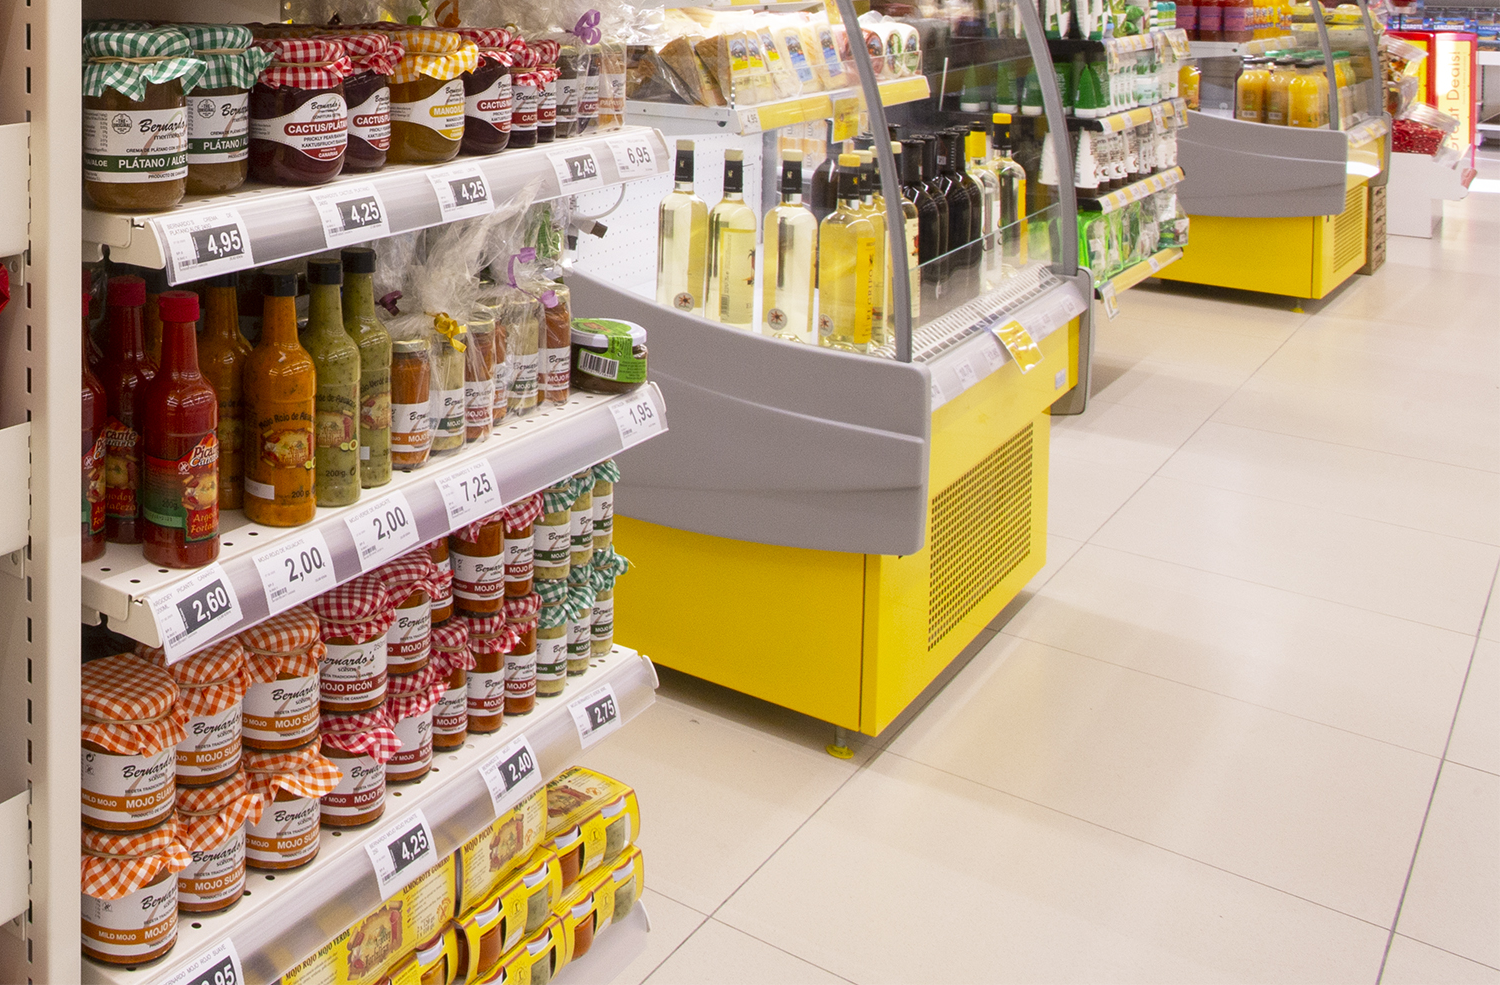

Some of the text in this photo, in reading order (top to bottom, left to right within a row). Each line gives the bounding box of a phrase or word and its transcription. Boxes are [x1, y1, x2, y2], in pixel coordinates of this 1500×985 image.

[203, 139, 239, 150] PLÁTANO
[119, 155, 186, 169] PLÁTANO ALOE
[275, 413, 290, 424] Rojo
[286, 538, 305, 552] AGUACATE
[176, 580, 194, 593] PICANTE
[197, 568, 215, 582] CANARIO
[320, 680, 373, 692] MOJO PICÓN
[275, 716, 300, 729] MOJO
[196, 751, 223, 763] MOJO
[97, 799, 117, 807] MOJO
[126, 796, 155, 809] MOJO
[354, 791, 376, 804] MOJO
[277, 836, 303, 849] MOJO
[195, 866, 244, 891] MOJO SUAVE
[99, 922, 169, 941] MILD MOJO MOJO
